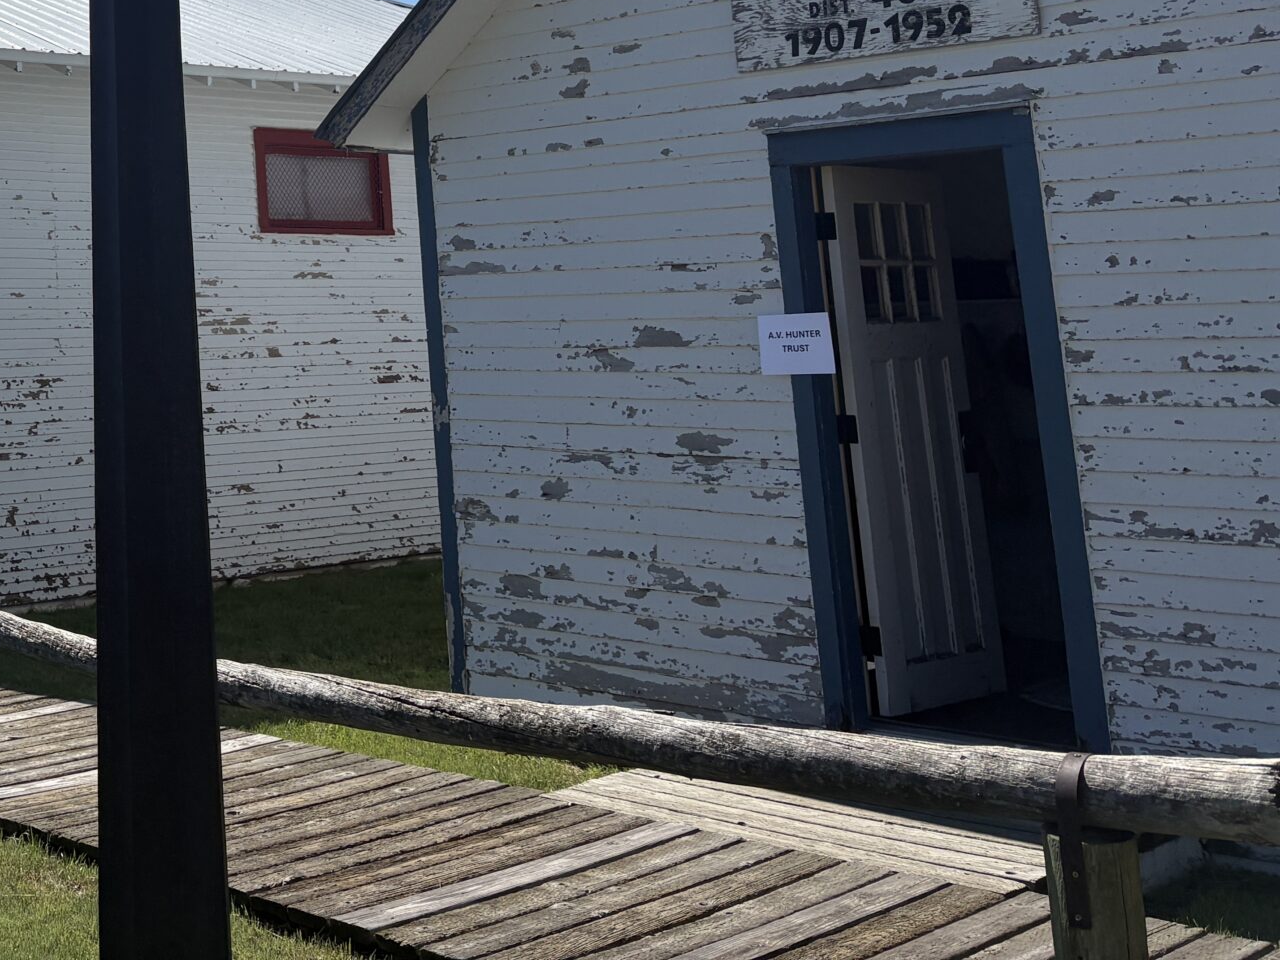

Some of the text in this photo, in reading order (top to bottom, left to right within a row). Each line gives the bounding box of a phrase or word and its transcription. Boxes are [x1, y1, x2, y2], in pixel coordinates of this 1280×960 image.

[784, 4, 972, 57] 1907-1952
[768, 329, 821, 339] A.V. HUNTER
[782, 344, 809, 352] TRUST
